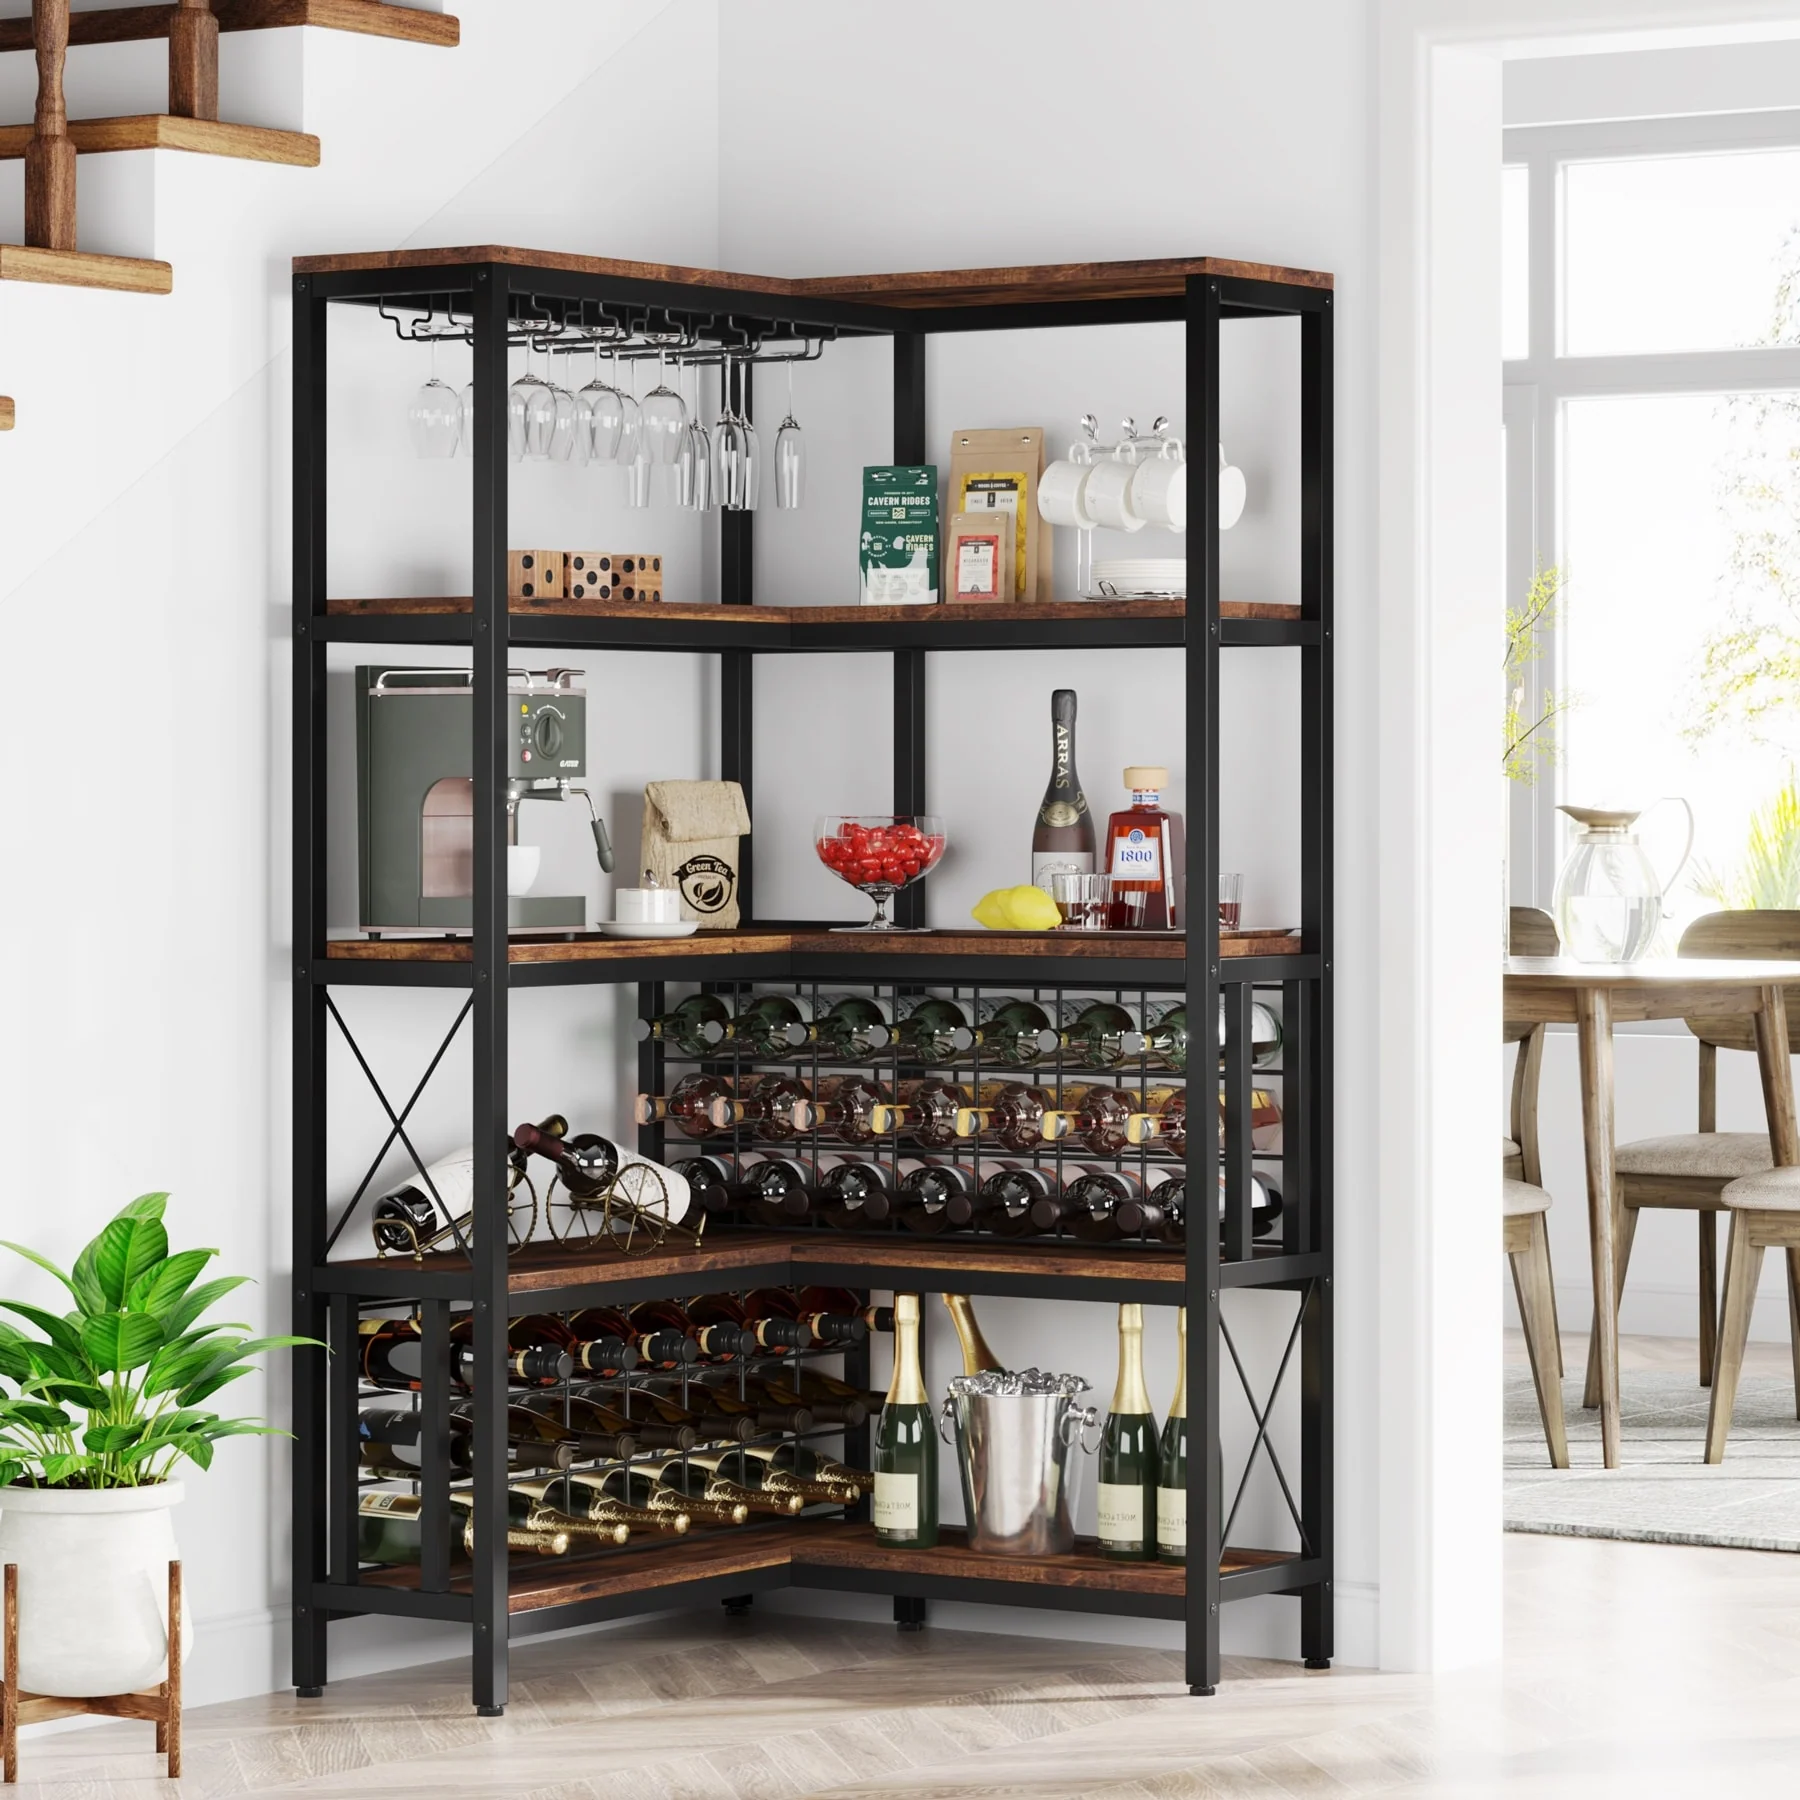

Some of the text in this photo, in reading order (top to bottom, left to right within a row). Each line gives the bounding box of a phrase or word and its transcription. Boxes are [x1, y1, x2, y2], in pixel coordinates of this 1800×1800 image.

[867, 496, 931, 506] CAVERN RIDGES
[905, 534, 934, 543] CAVERN
[905, 543, 934, 551] RIDGES
[1055, 723, 1069, 788] ARRAS
[1121, 850, 1152, 862] 1800
[686, 861, 728, 876] Green Tea
